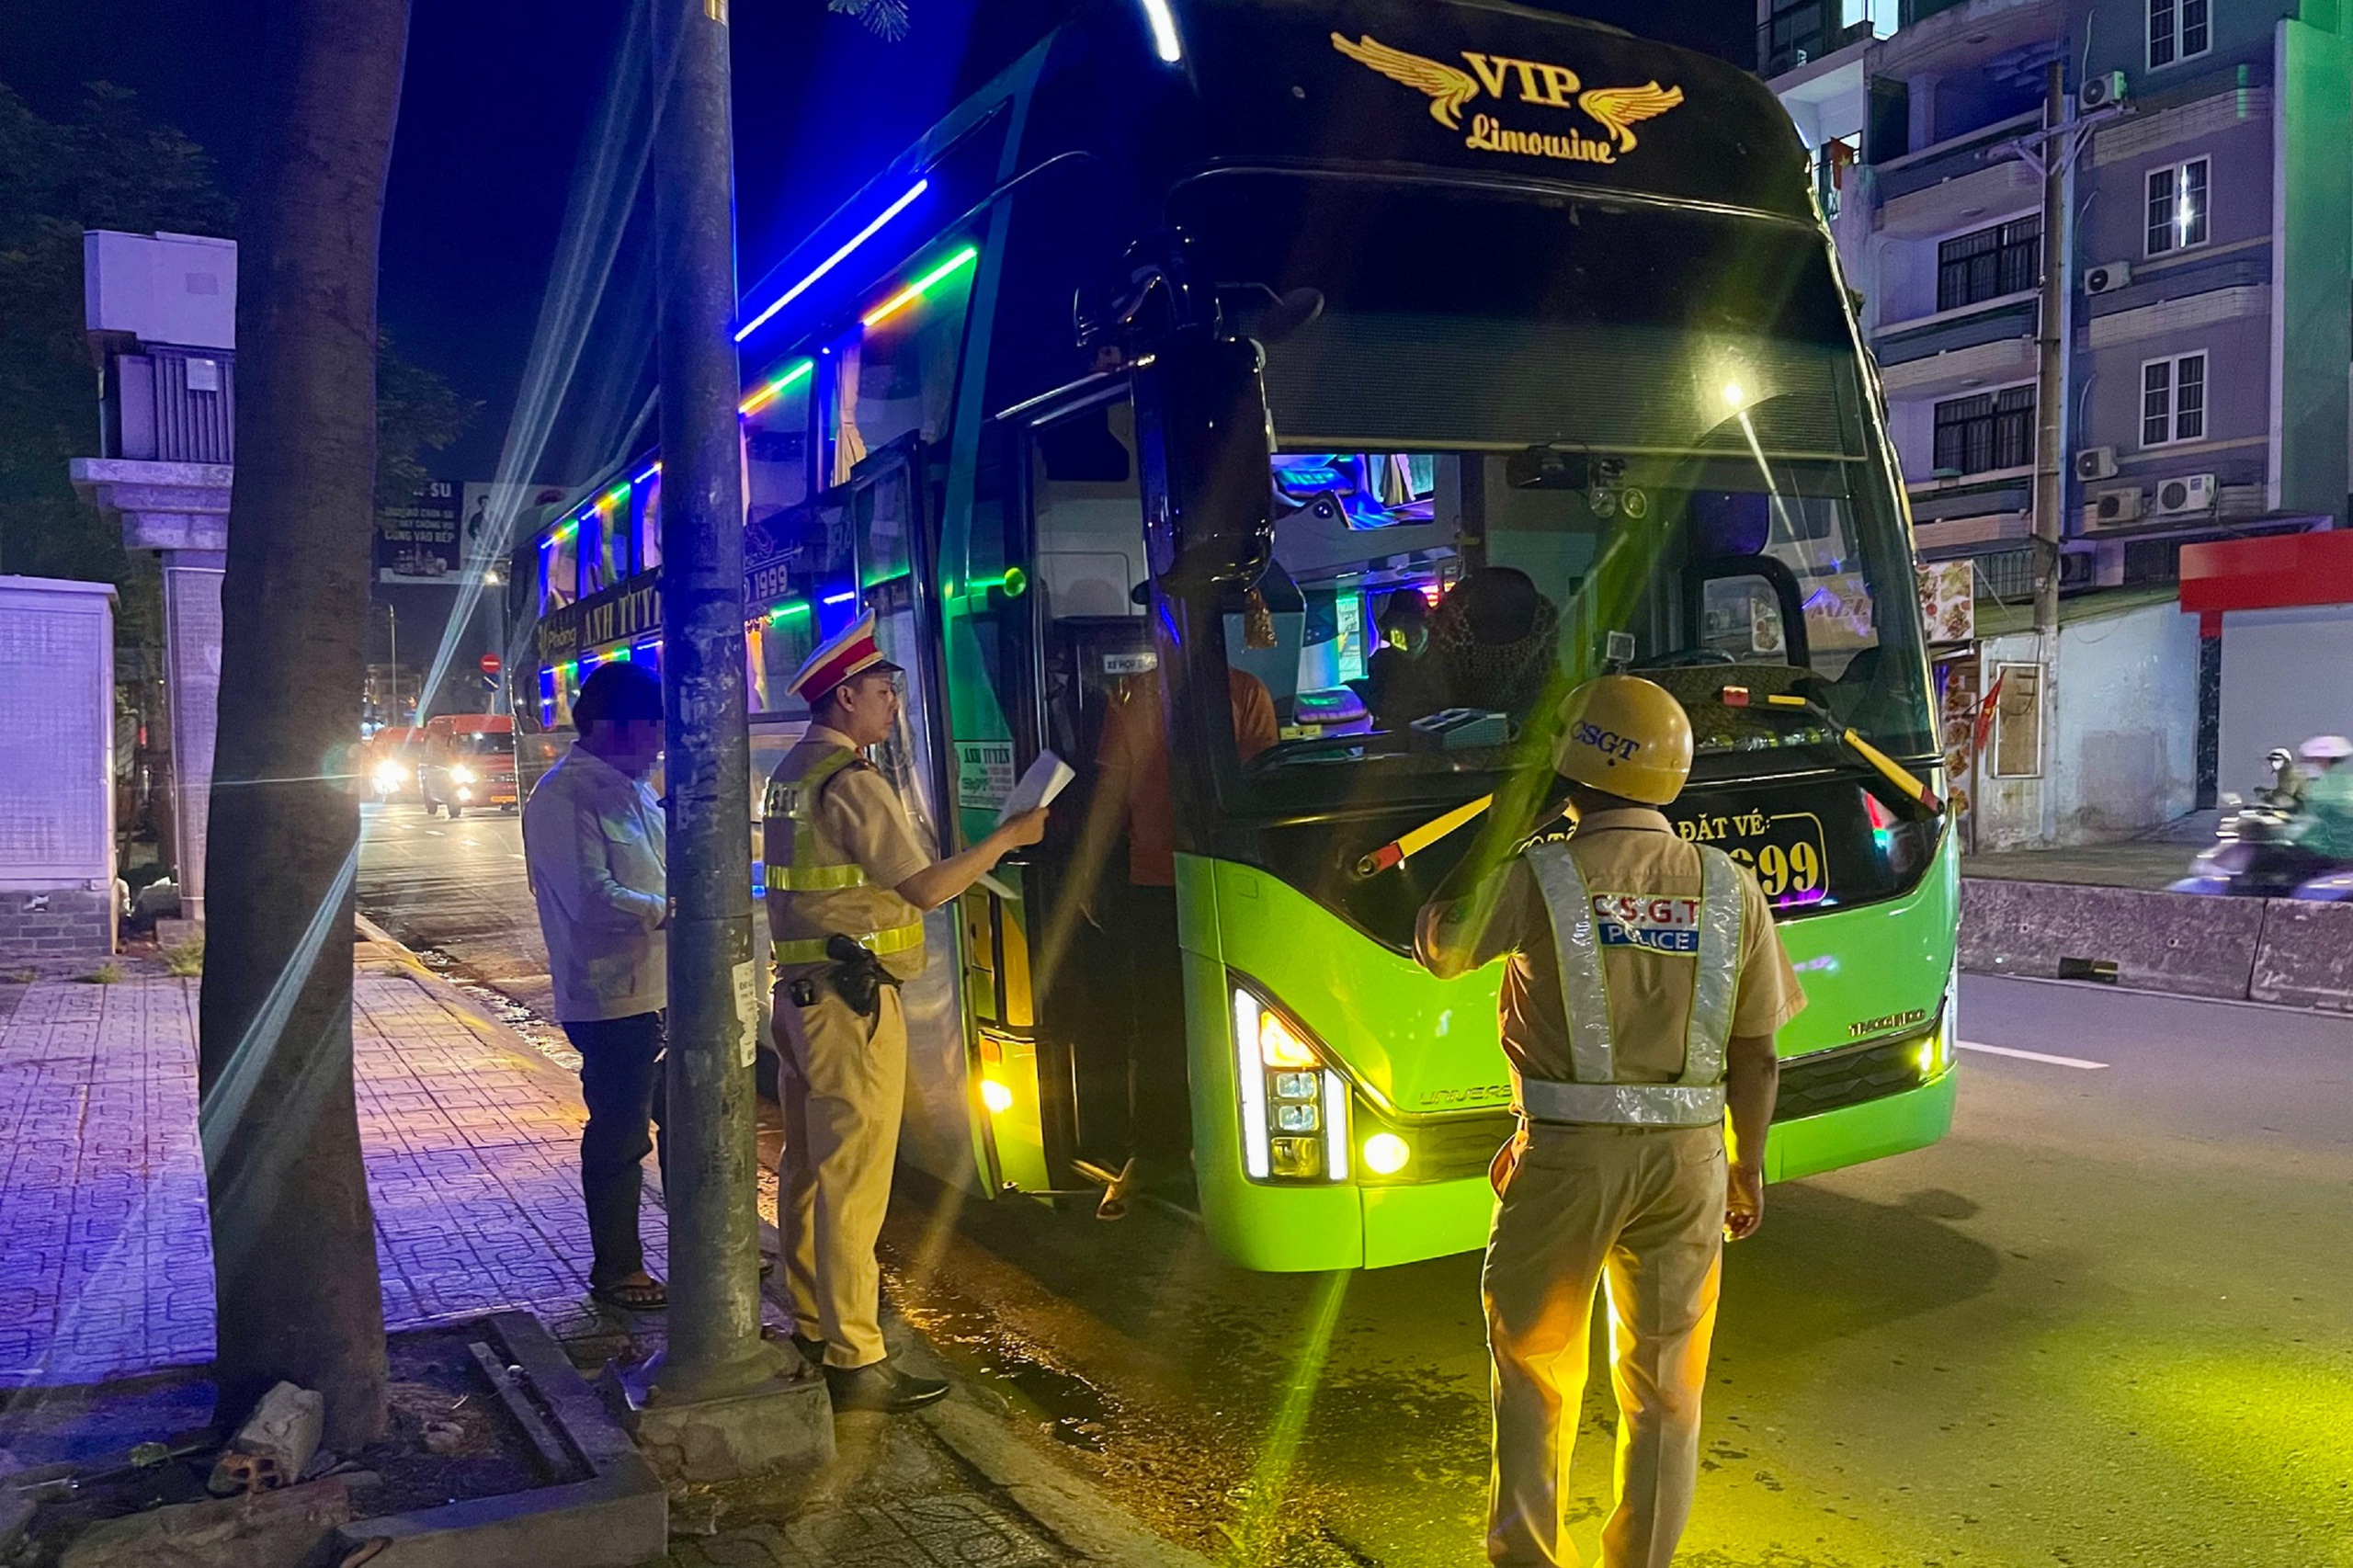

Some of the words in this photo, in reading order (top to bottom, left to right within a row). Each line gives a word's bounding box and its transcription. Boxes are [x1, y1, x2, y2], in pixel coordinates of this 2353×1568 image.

[1461, 51, 1581, 108] VIP
[1466, 114, 1617, 165] Limousine
[754, 564, 789, 600] 1999
[1571, 720, 1641, 761] CSGT
[1608, 925, 1690, 950] POLICE
